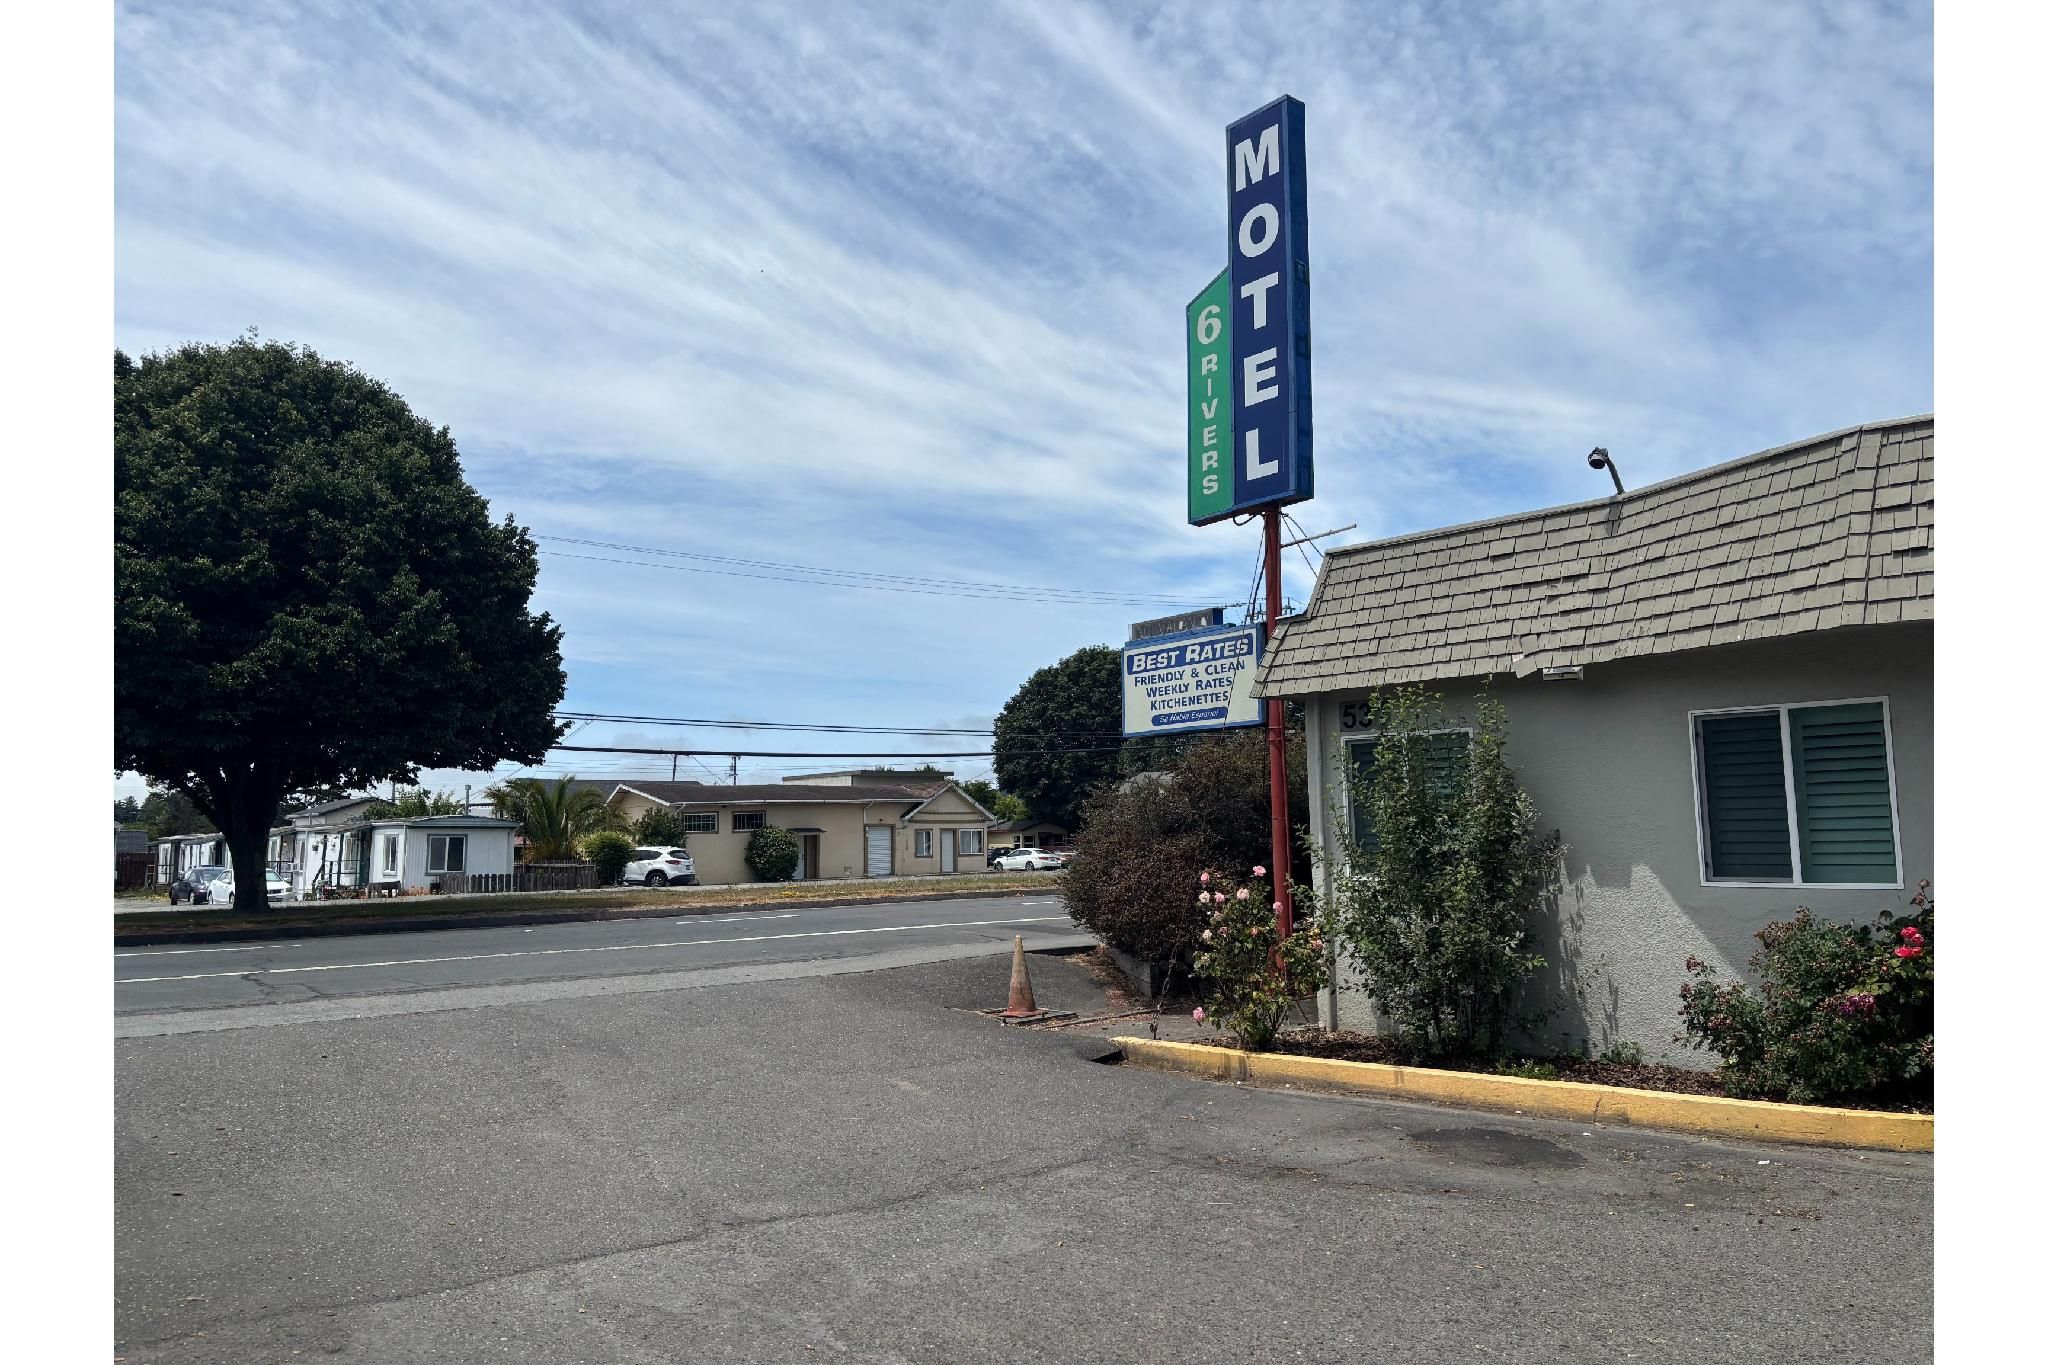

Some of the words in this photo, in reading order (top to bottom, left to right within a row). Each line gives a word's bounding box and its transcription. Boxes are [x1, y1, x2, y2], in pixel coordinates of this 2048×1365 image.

[1234, 123, 1280, 481] MOTEL
[1196, 304, 1222, 346] 6
[1201, 354, 1218, 496] RIVERS
[1132, 651, 1180, 672] BEST
[1185, 638, 1249, 663] RATES
[1134, 670, 1185, 687] FRIENDLY
[1191, 668, 1200, 678] &
[1205, 659, 1245, 676] CLEAN
[1146, 683, 1189, 698] WEEKLY
[1195, 677, 1232, 691] RATES
[1150, 690, 1229, 711] KITCHENETTES
